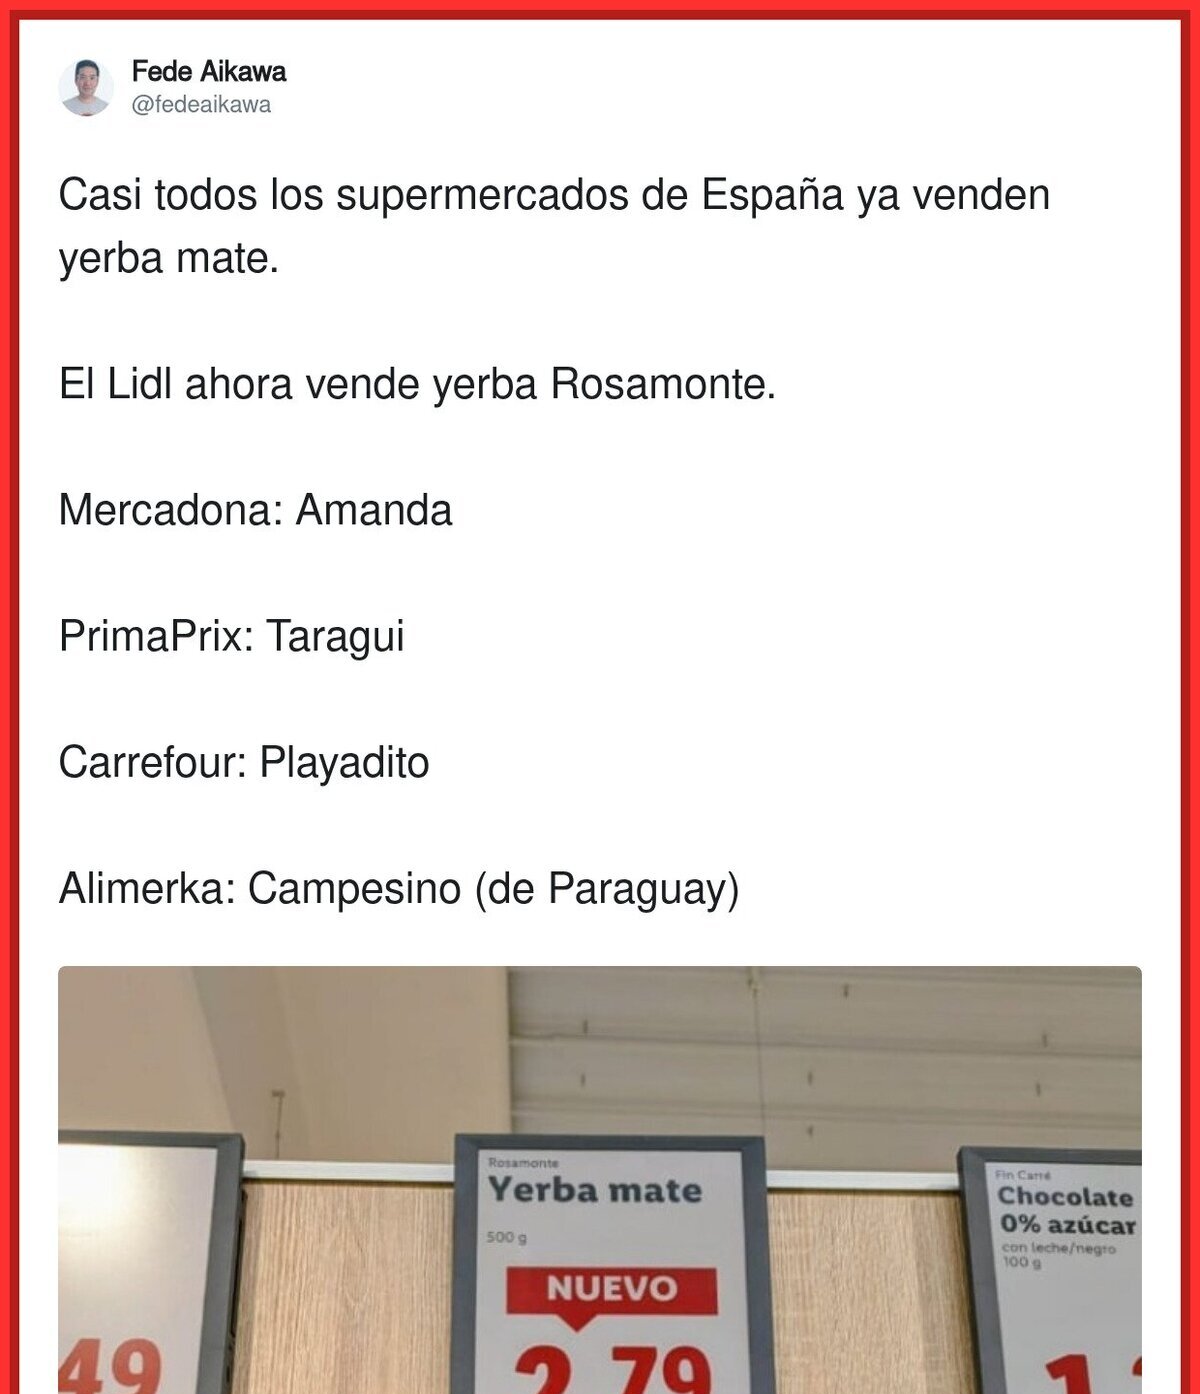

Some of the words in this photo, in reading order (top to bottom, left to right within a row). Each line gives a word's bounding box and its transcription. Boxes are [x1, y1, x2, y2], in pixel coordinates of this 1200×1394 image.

[488, 1157, 559, 1169] Rosamonte
[995, 1169, 1015, 1180] Fin
[488, 1175, 598, 1203] Yerba
[609, 1179, 702, 1203] mate
[998, 1185, 1134, 1207] Chocolate
[1001, 1213, 1041, 1233] 0%
[1048, 1215, 1136, 1235] azúcar
[487, 1231, 514, 1244] 500
[518, 1233, 527, 1245] g
[1002, 1243, 1028, 1253] con
[1032, 1242, 1117, 1257] leche/negro
[1004, 1256, 1029, 1268] 100
[1032, 1259, 1042, 1270] g
[548, 1275, 678, 1302] NUEVO
